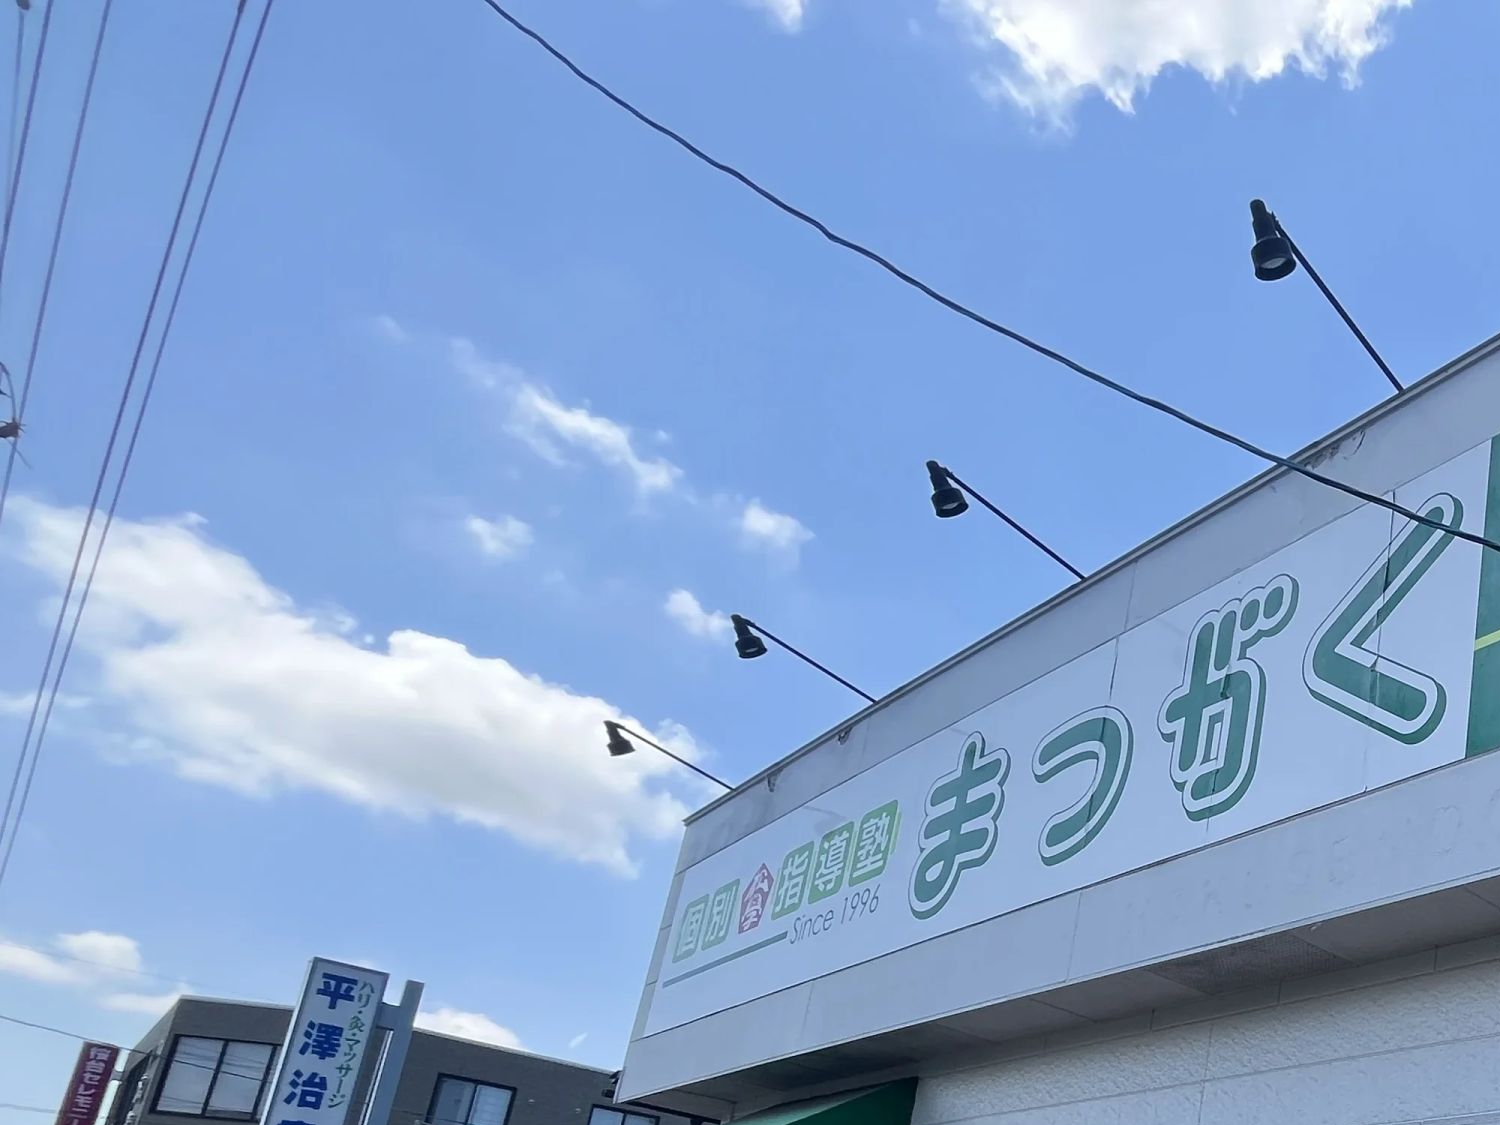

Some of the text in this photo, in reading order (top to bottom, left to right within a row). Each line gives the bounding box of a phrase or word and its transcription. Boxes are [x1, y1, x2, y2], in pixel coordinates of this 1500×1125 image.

[907, 491, 1464, 921] まつがく
[789, 882, 882, 946] Since 1996
